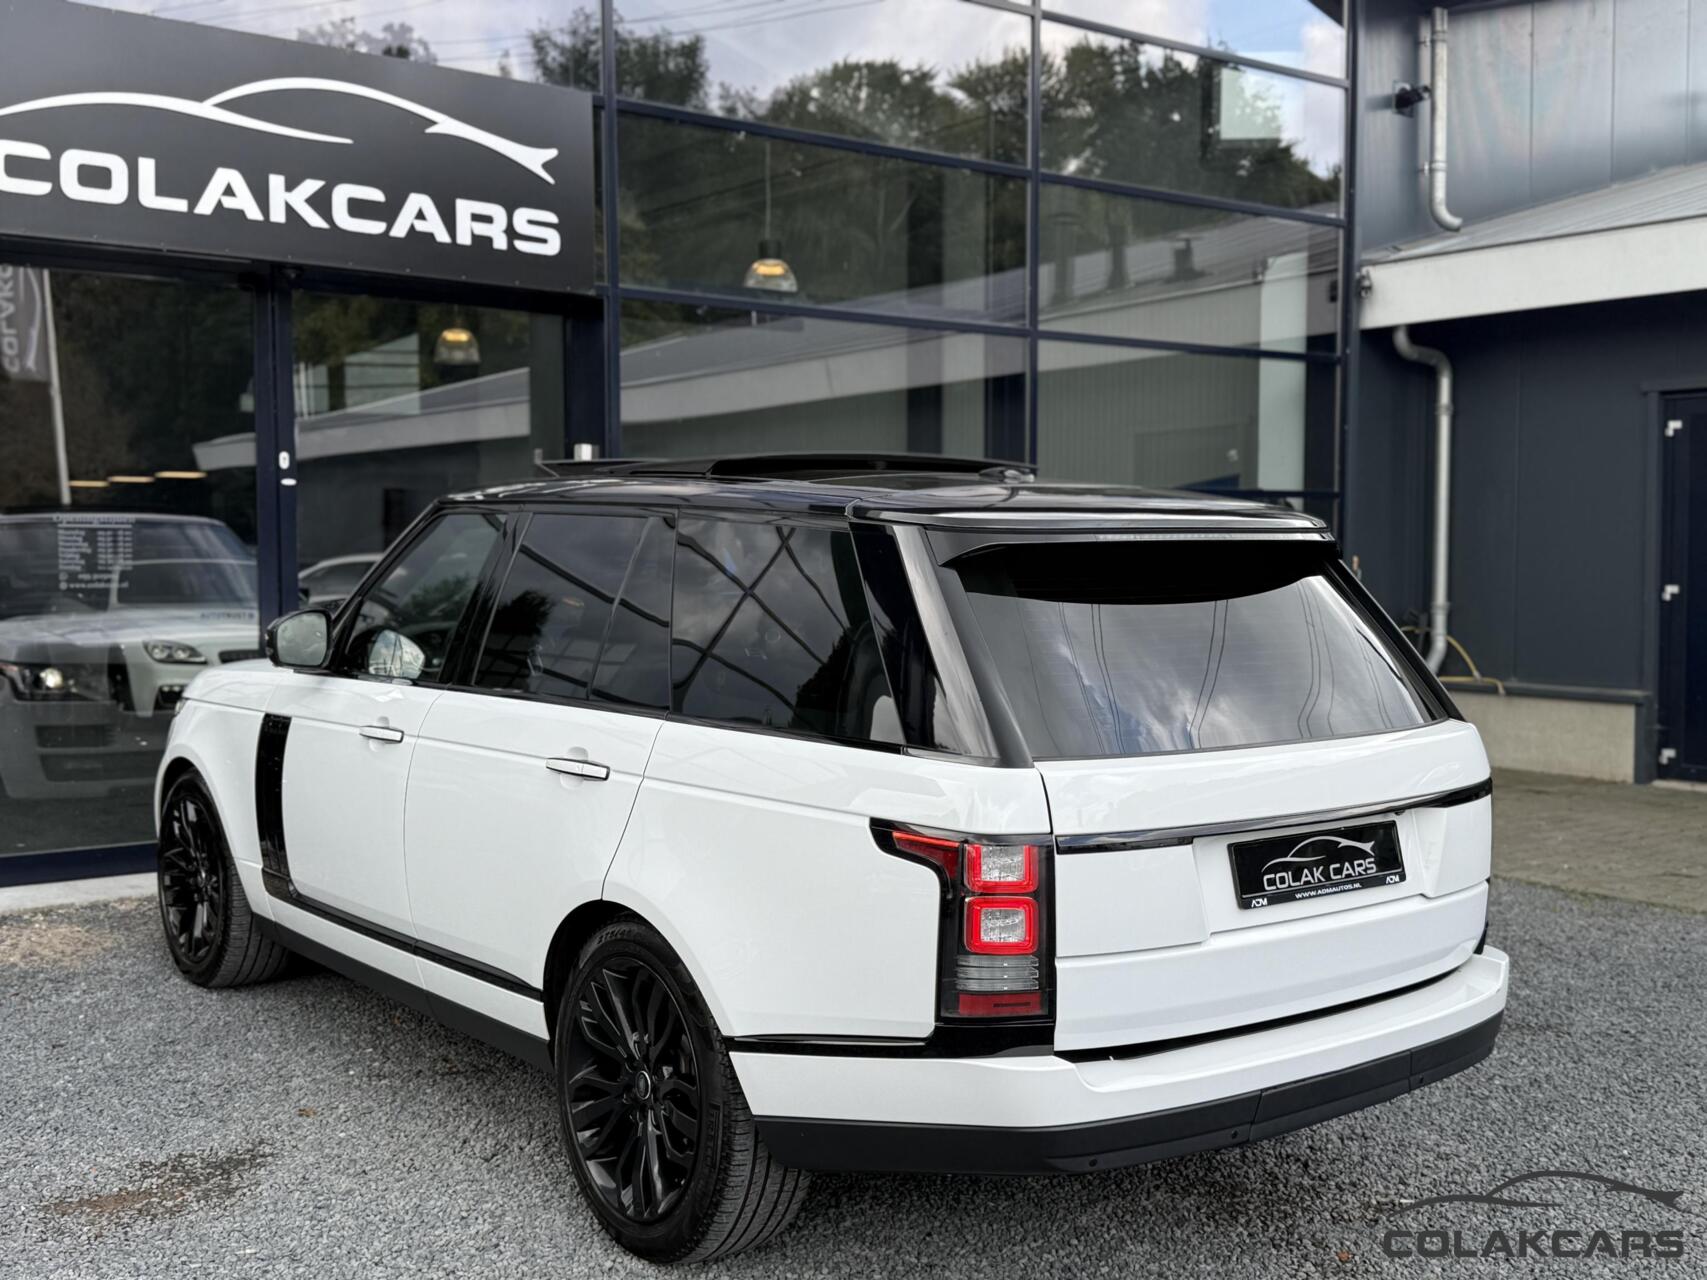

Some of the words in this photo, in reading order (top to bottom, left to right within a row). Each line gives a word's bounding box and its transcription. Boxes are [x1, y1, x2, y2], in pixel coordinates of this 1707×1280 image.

[0, 139, 562, 257] COLAKCARS
[1263, 865, 1326, 891] COLAK
[1329, 857, 1377, 880] CARS
[1295, 882, 1362, 899] WWW.ADMAUTOS.NL
